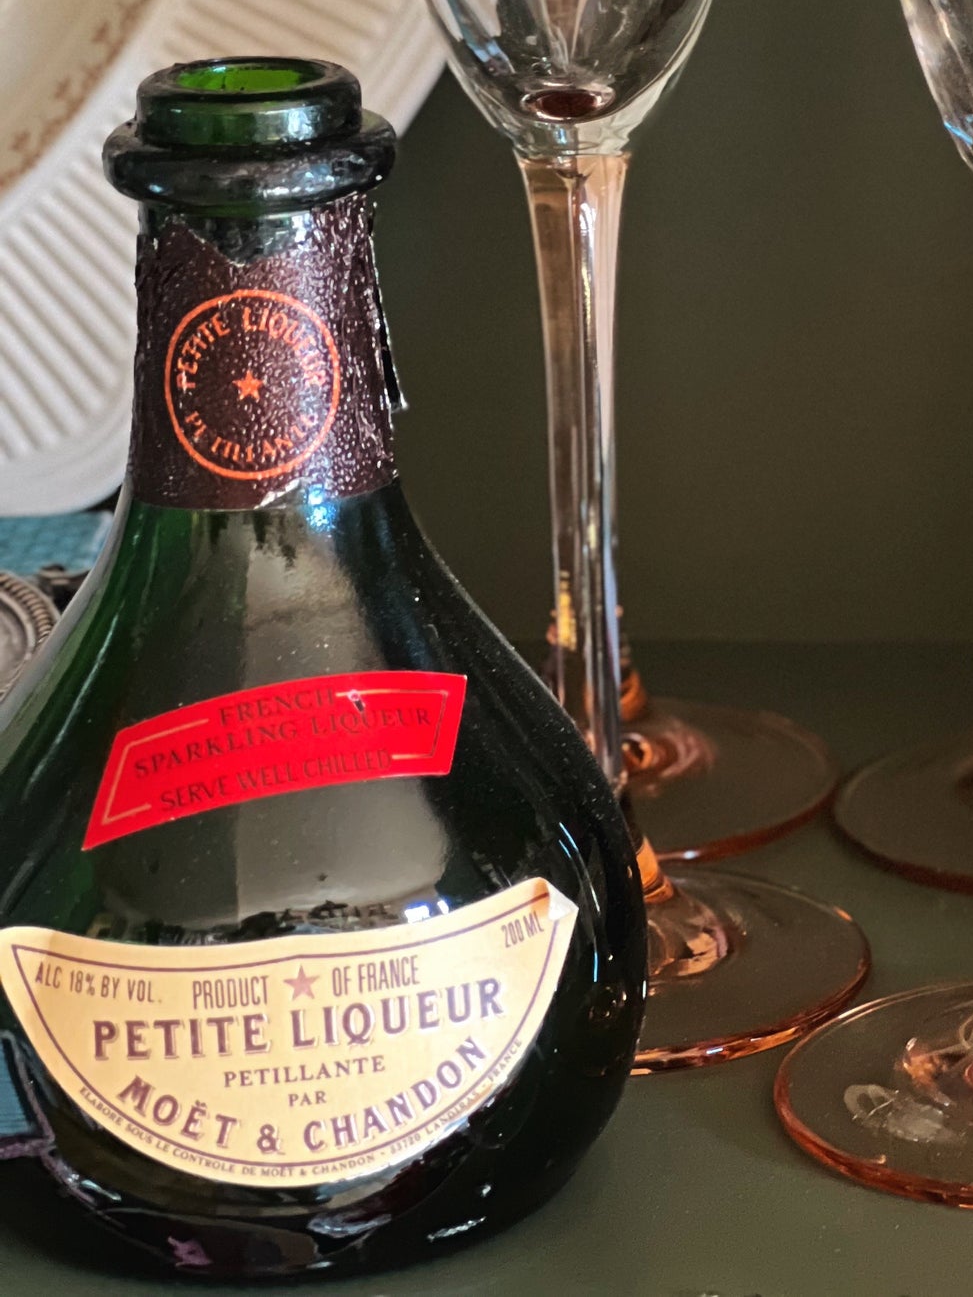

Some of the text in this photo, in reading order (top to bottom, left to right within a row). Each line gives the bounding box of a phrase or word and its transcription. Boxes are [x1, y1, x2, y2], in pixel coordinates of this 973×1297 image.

[219, 687, 334, 726] FRENCH
[134, 708, 431, 779] SPARKLING LIQUEUR
[160, 748, 392, 812] SERVE WELL CHILLED
[501, 910, 545, 948] 200 ML
[35, 961, 162, 1004] ALC 18% BY VOL.
[192, 955, 420, 1010] PRODUCT OF FRANCE
[93, 977, 505, 1061] PETITE LIQUEUR
[117, 1036, 487, 1155] MOËT & CHANDON
[223, 1055, 386, 1088] PETILLANTE
[288, 1090, 327, 1108] PAR
[79, 1086, 122, 1126] ELABORE
[125, 1123, 153, 1145] SOUS
[156, 1139, 170, 1152] LE
[172, 1148, 236, 1173] CONTROLE
[241, 1165, 256, 1176] DE
[312, 1154, 375, 1175] CHANDON
[487, 1039, 522, 1083] FRANCE
